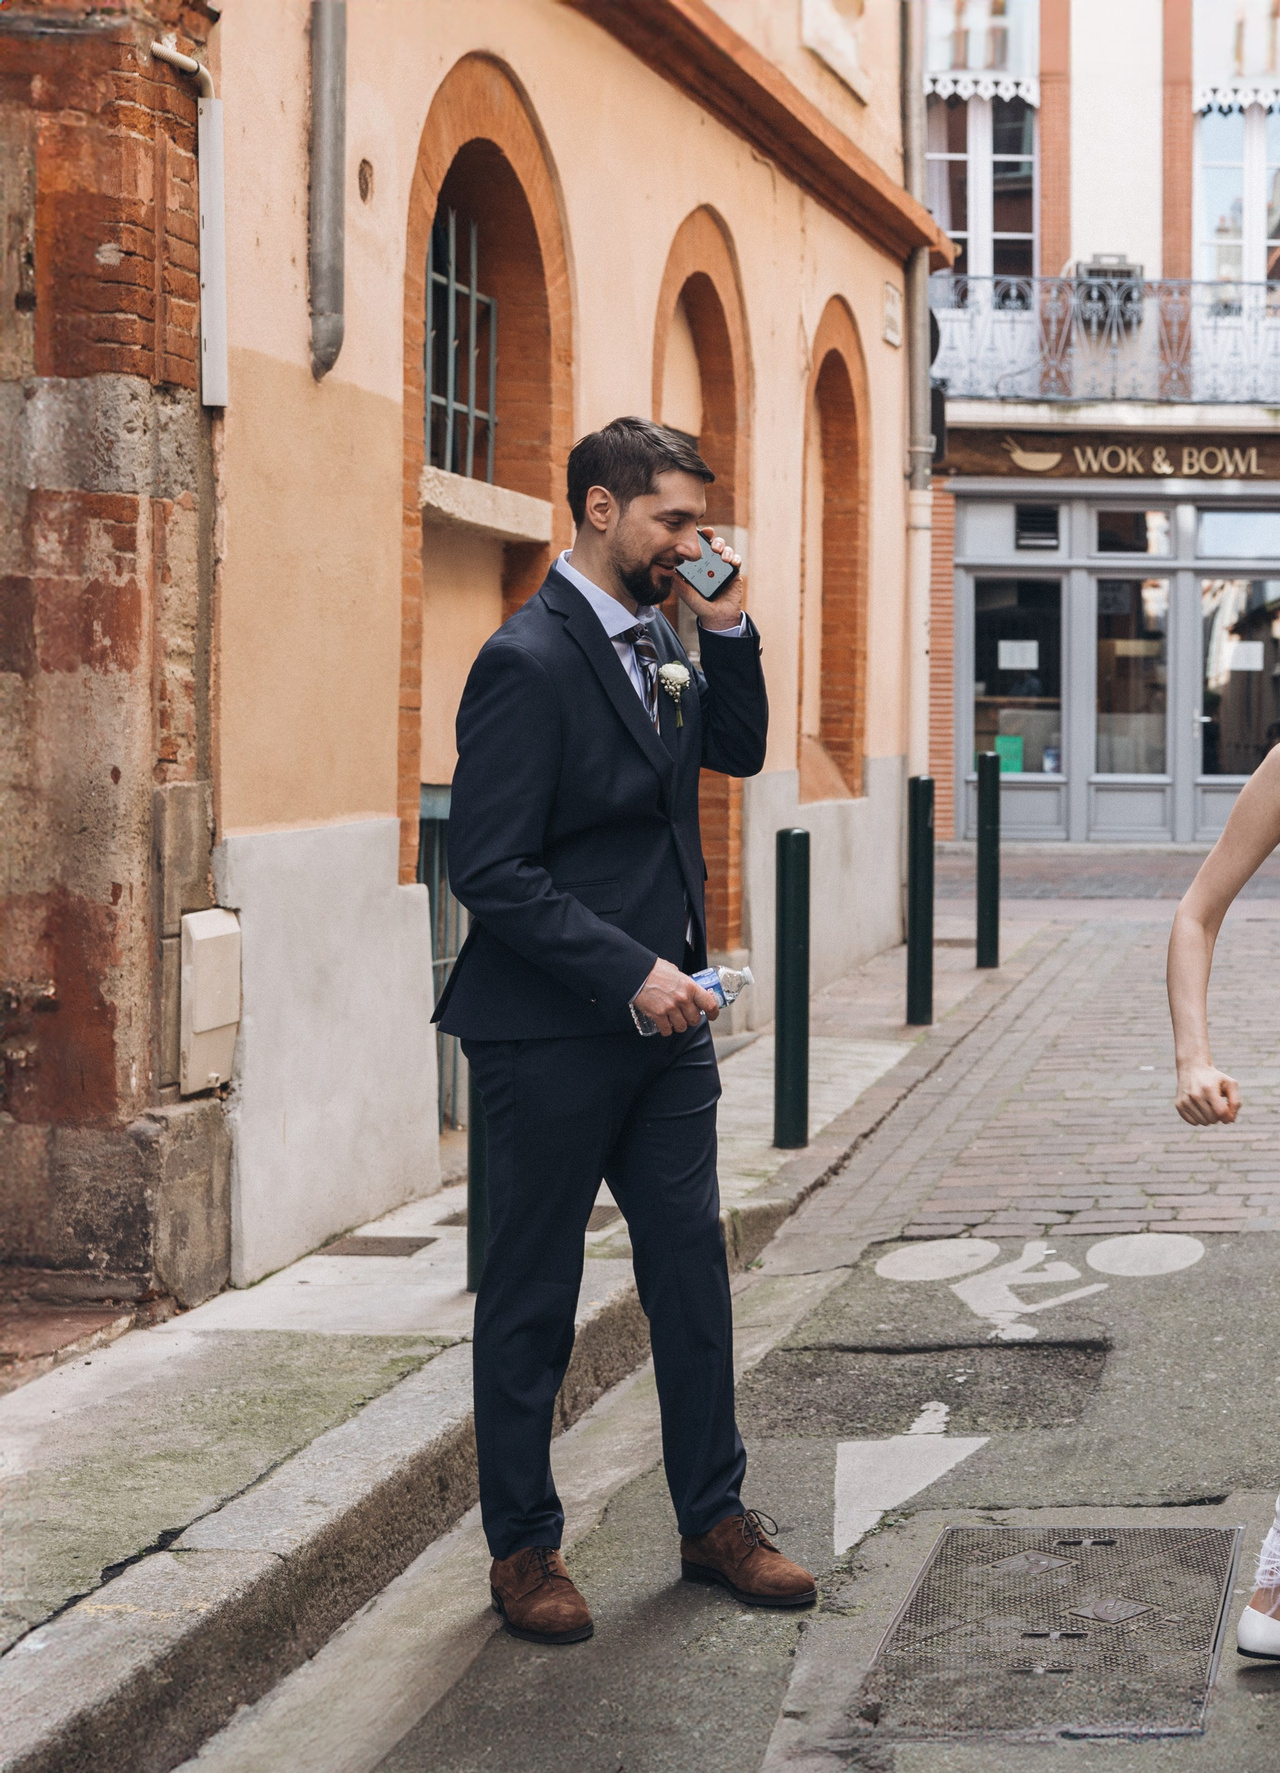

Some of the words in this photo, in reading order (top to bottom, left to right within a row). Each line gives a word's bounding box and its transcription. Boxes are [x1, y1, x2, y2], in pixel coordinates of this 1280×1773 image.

[1073, 445, 1145, 474] WOK
[1152, 446, 1175, 475] &
[1181, 446, 1265, 475] BOWL
